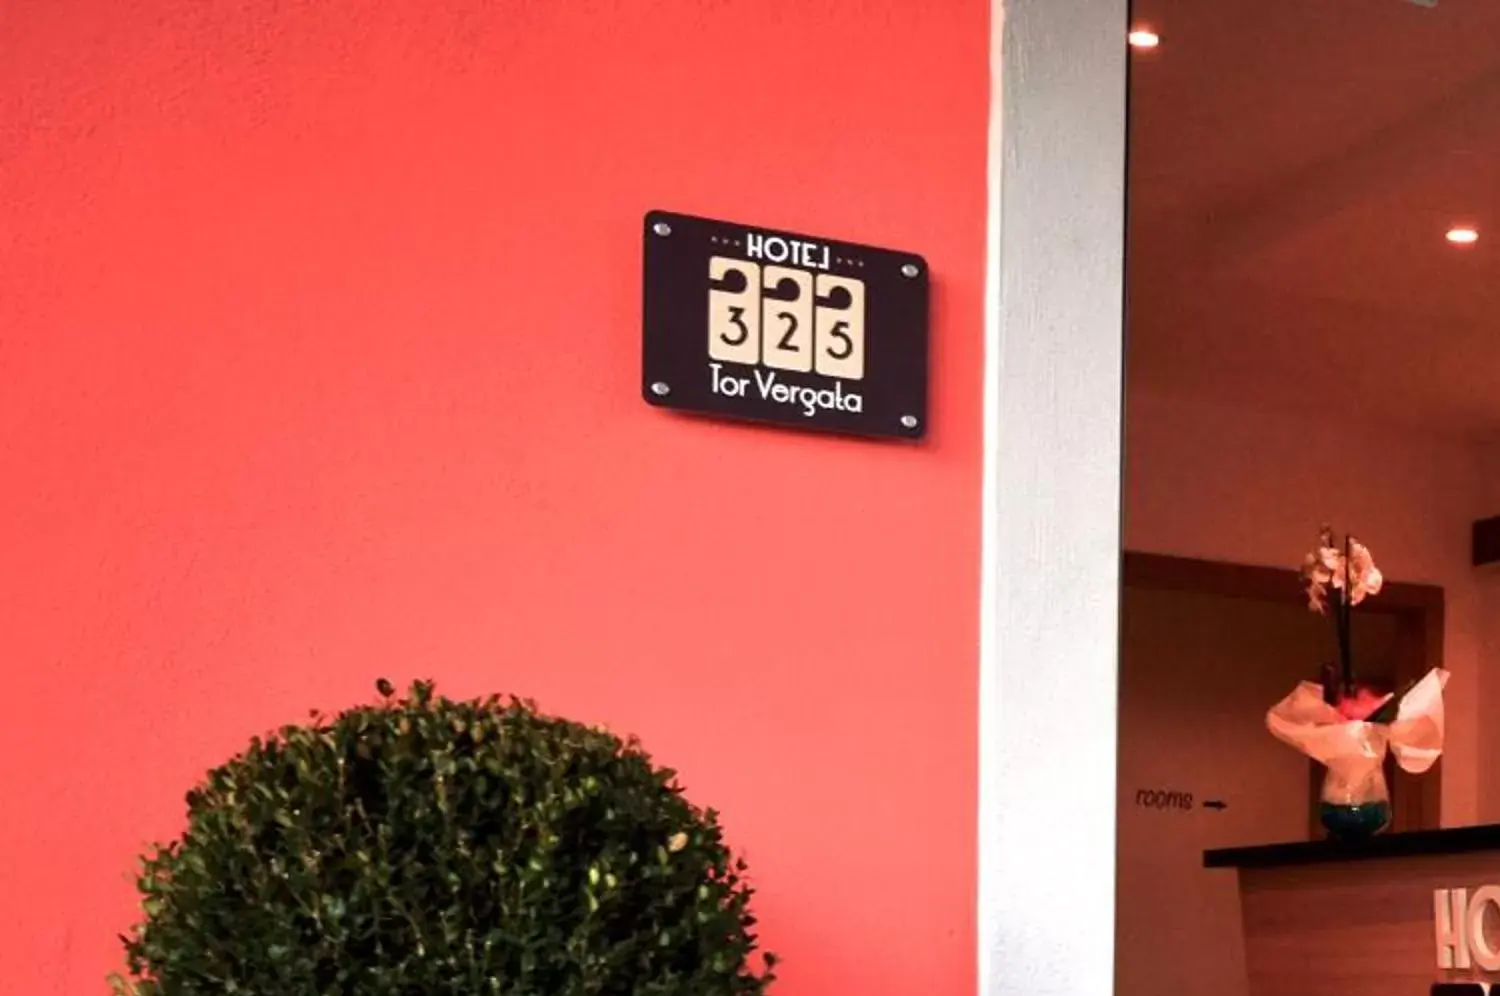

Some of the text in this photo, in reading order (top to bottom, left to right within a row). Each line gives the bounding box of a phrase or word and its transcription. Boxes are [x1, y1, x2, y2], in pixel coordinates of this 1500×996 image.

[747, 233, 830, 270] HOTEL
[708, 363, 863, 416] Tor Vergata
[1135, 789, 1193, 811] rooms
